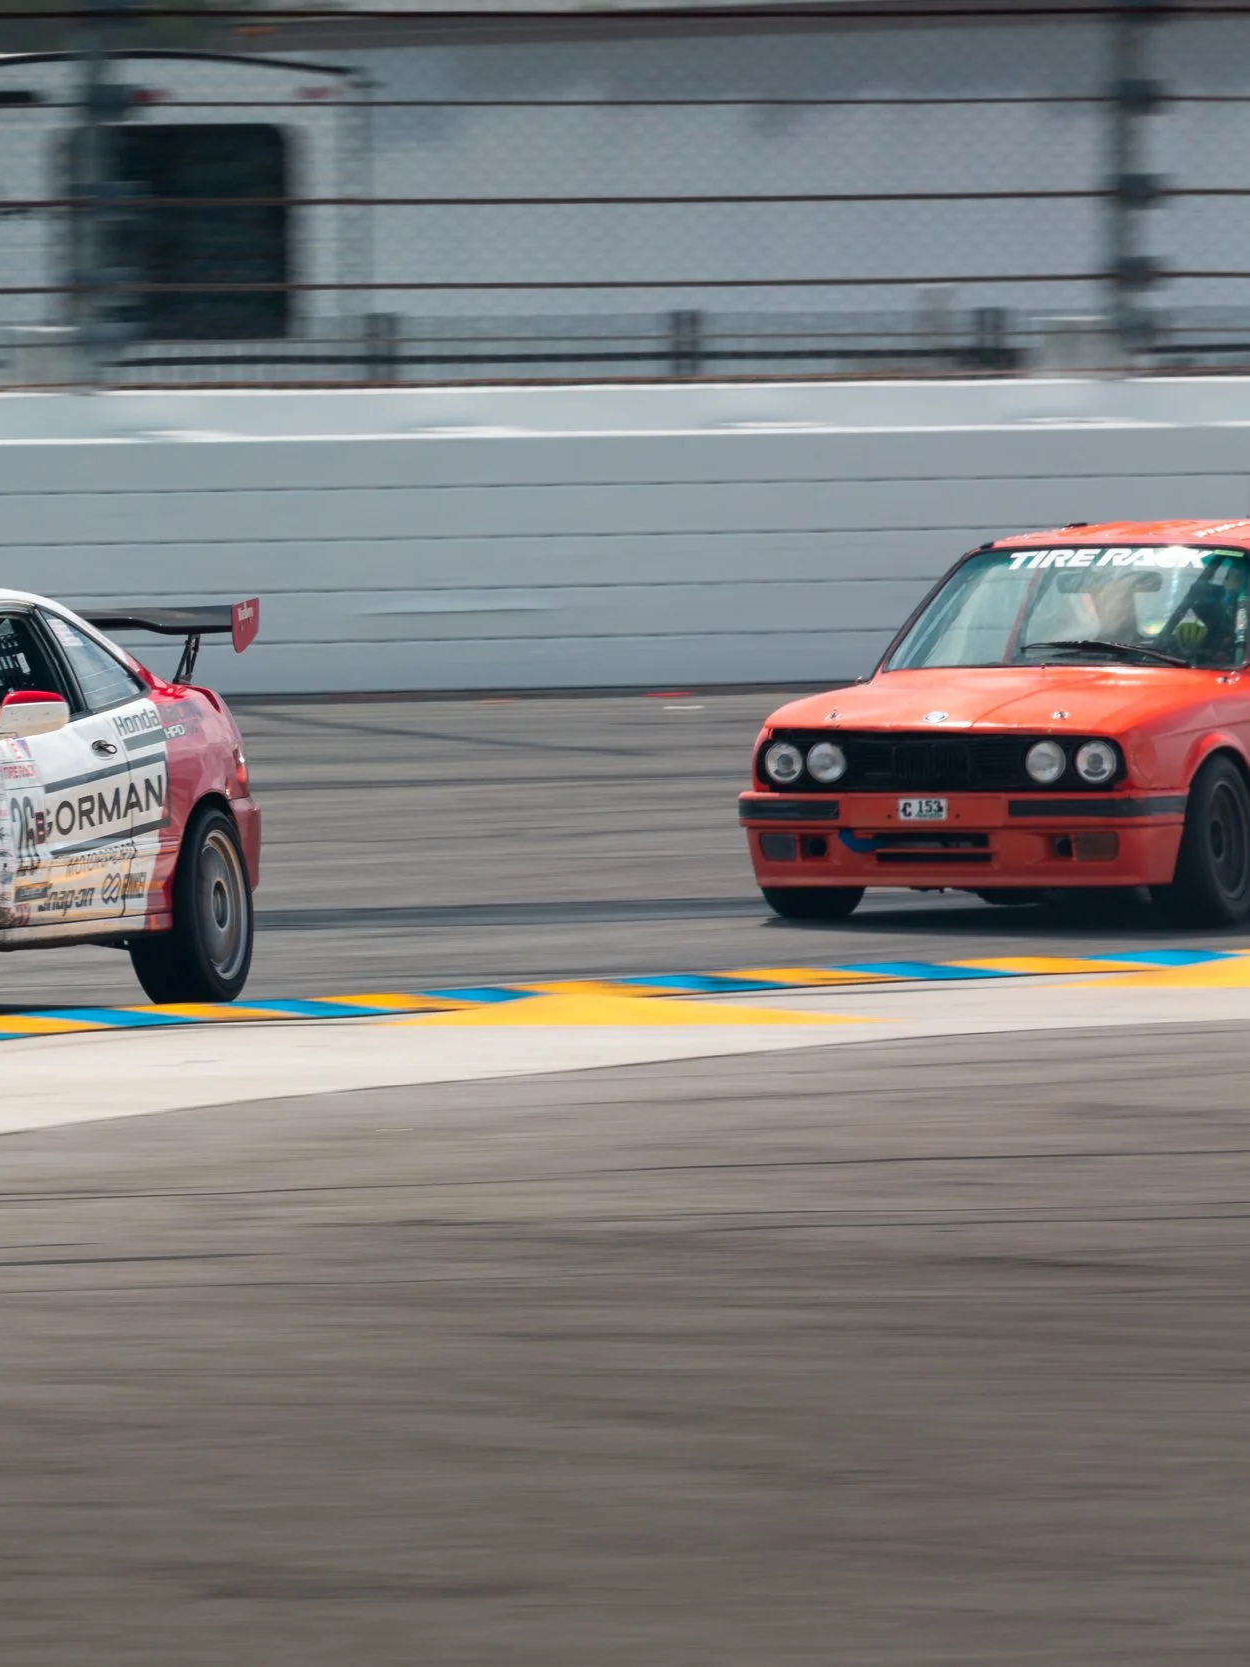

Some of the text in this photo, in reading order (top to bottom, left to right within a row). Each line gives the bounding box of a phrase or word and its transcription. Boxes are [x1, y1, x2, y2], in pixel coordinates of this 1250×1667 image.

[1008, 546, 1213, 570] TIRE RACK
[112, 707, 161, 737] Honda
[918, 800, 944, 813] 153
